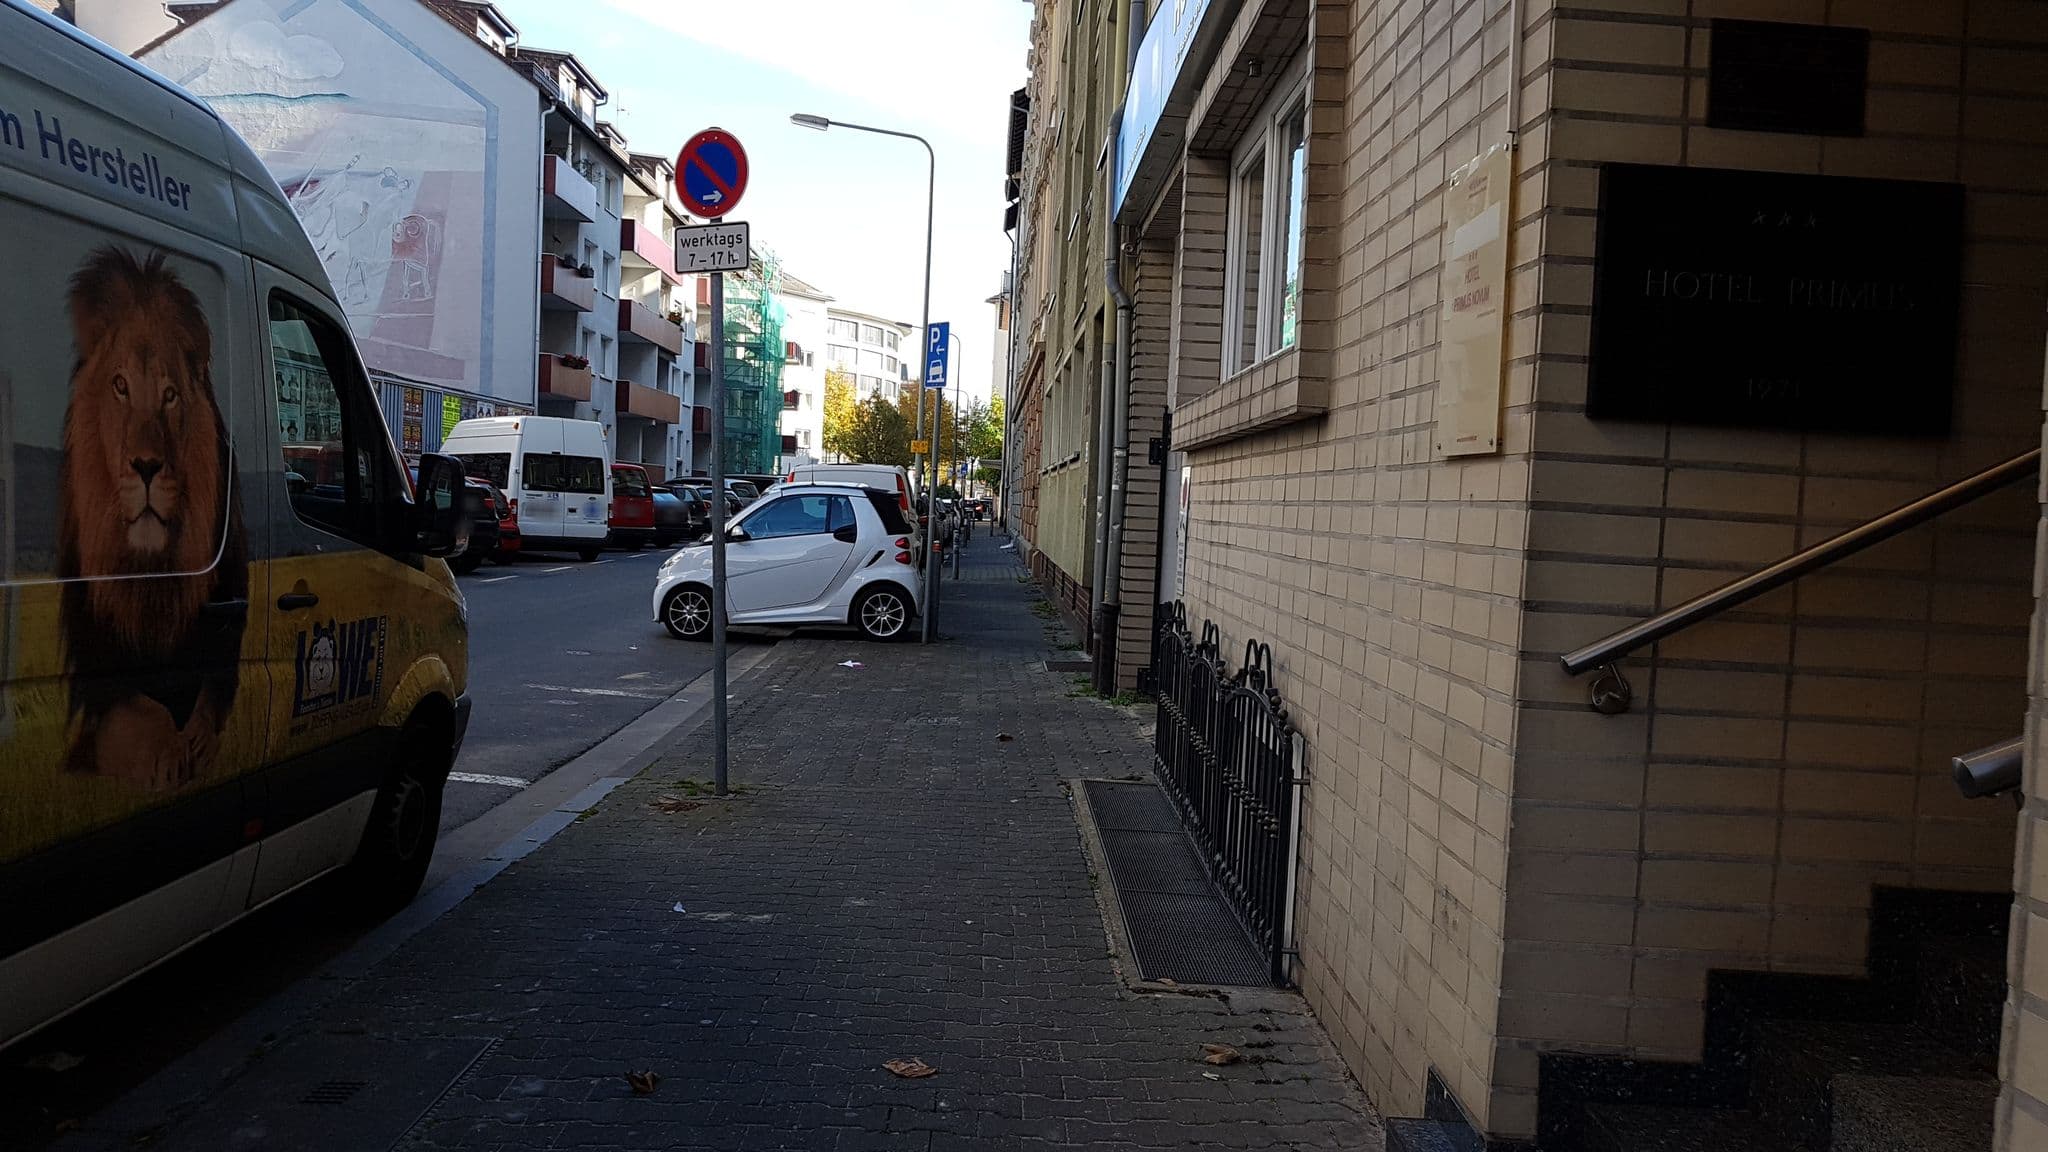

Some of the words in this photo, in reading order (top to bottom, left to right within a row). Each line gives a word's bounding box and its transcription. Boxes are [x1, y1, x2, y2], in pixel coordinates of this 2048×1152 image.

[34, 109, 191, 211] Hersteller
[680, 232, 743, 248] werktags
[1644, 268, 1763, 304] HOTEL
[1788, 277, 1917, 312] PRIMUS
[930, 327, 940, 353] P
